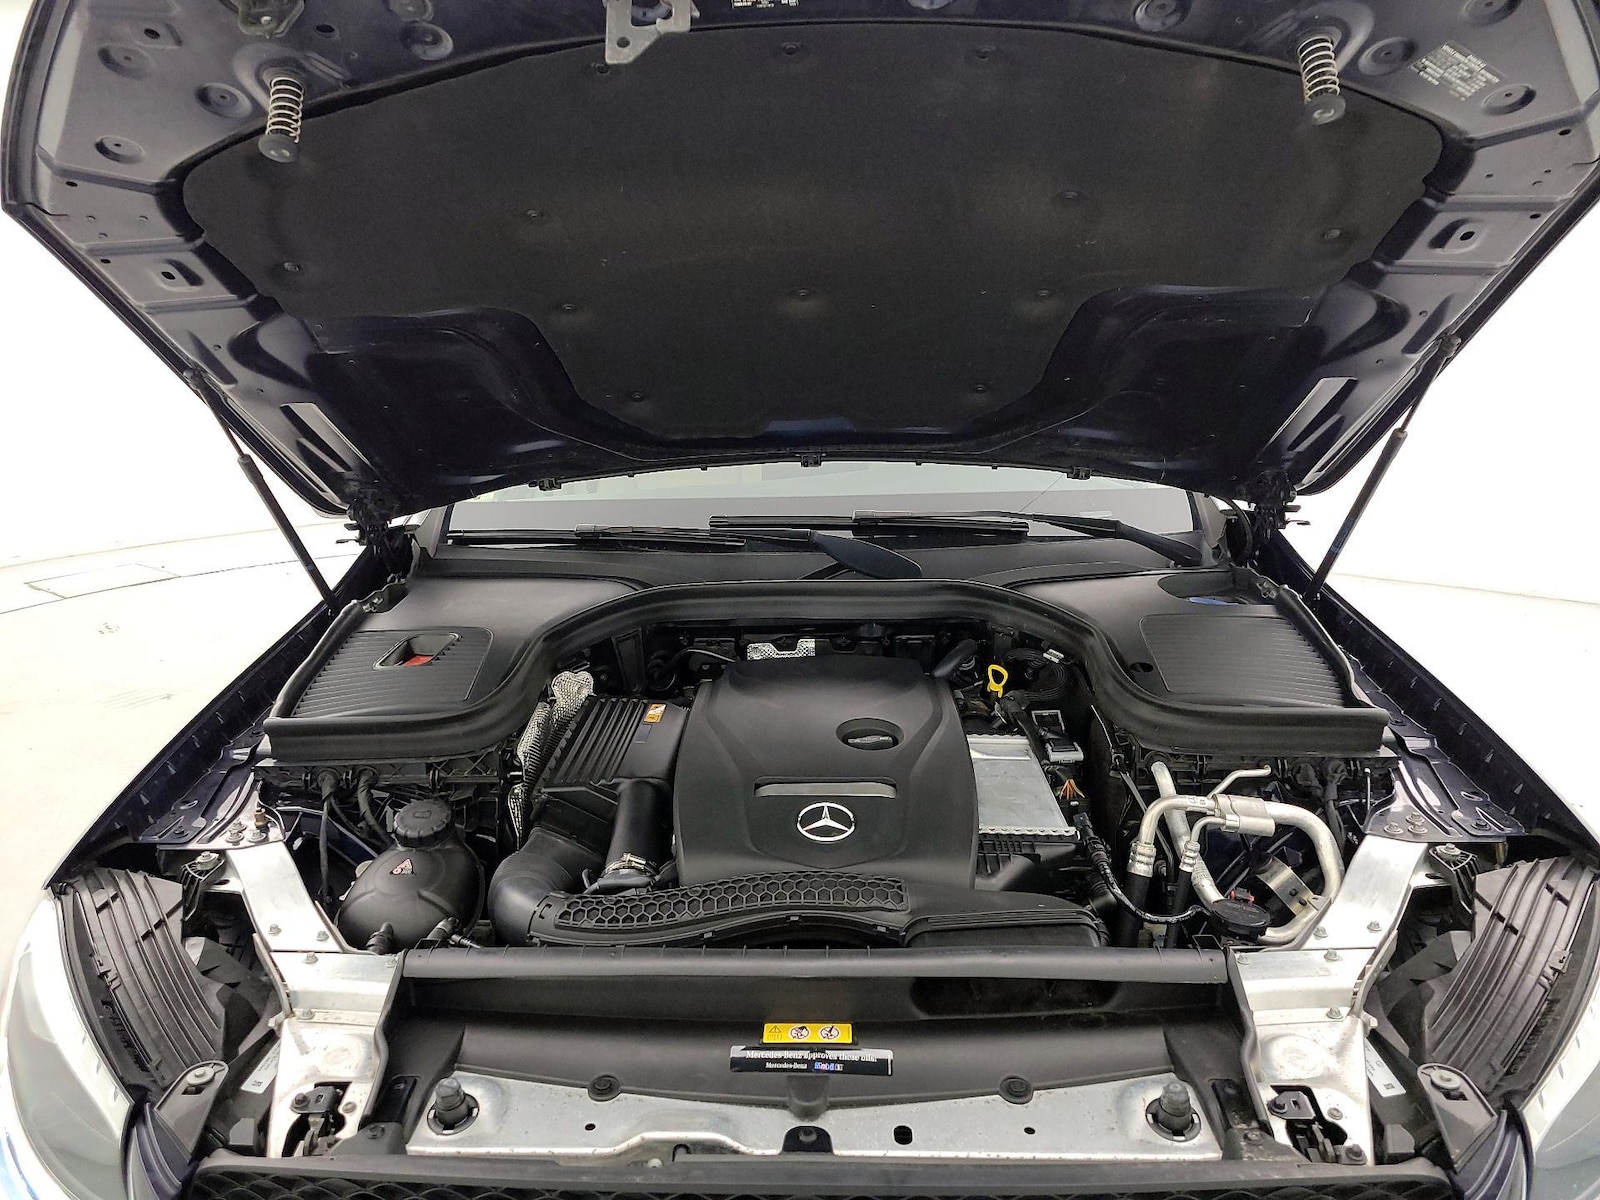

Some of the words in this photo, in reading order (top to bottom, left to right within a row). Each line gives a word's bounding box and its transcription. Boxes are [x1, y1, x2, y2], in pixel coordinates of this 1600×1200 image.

[745, 1050, 803, 1059] Mercedes-Benz
[803, 1051, 837, 1060] approves
[839, 1052, 860, 1061] these
[765, 1061, 808, 1070] Mercedes-Benz
